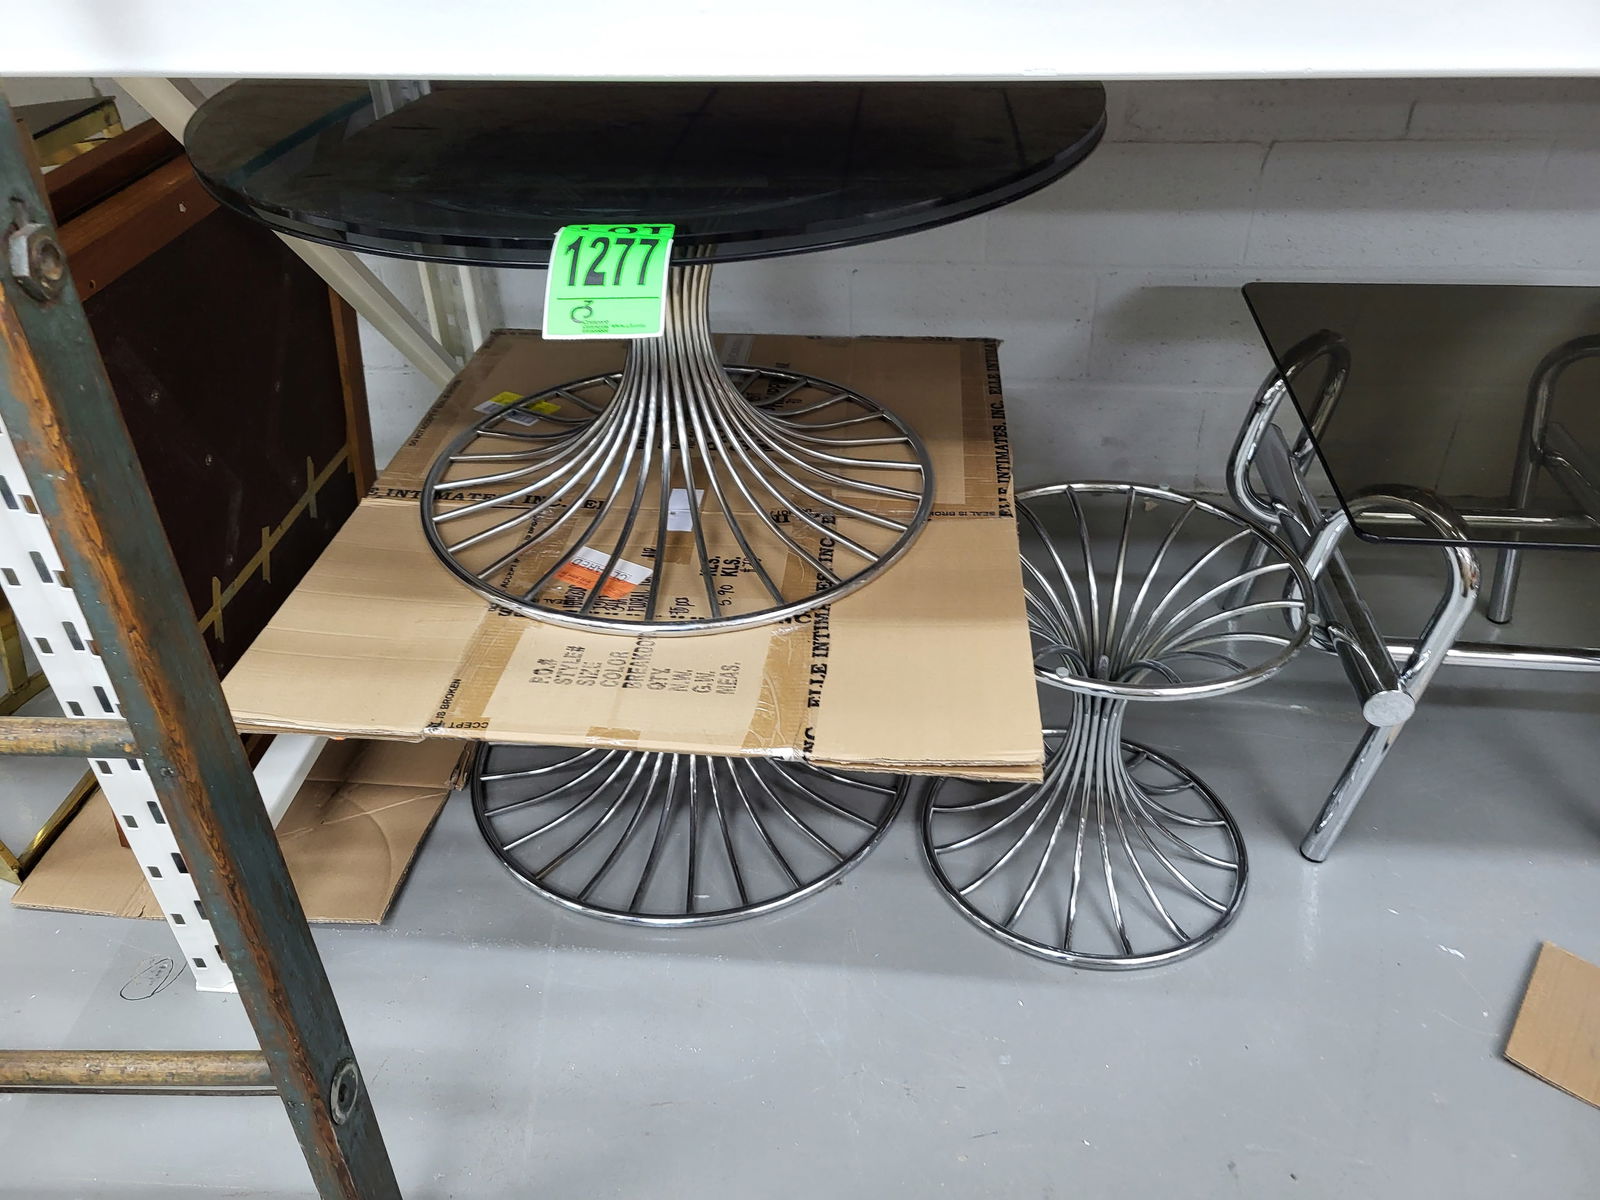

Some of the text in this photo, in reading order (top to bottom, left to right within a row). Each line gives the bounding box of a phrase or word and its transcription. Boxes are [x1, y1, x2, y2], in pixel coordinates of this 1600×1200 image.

[565, 236, 660, 286] 1277
[720, 556, 742, 577] KLS.
[576, 661, 602, 687] SIZE
[600, 648, 630, 688] COLOR
[715, 662, 742, 694] MEAS.
[440, 679, 462, 710] BROKEN
[447, 721, 489, 729] CCEPT
